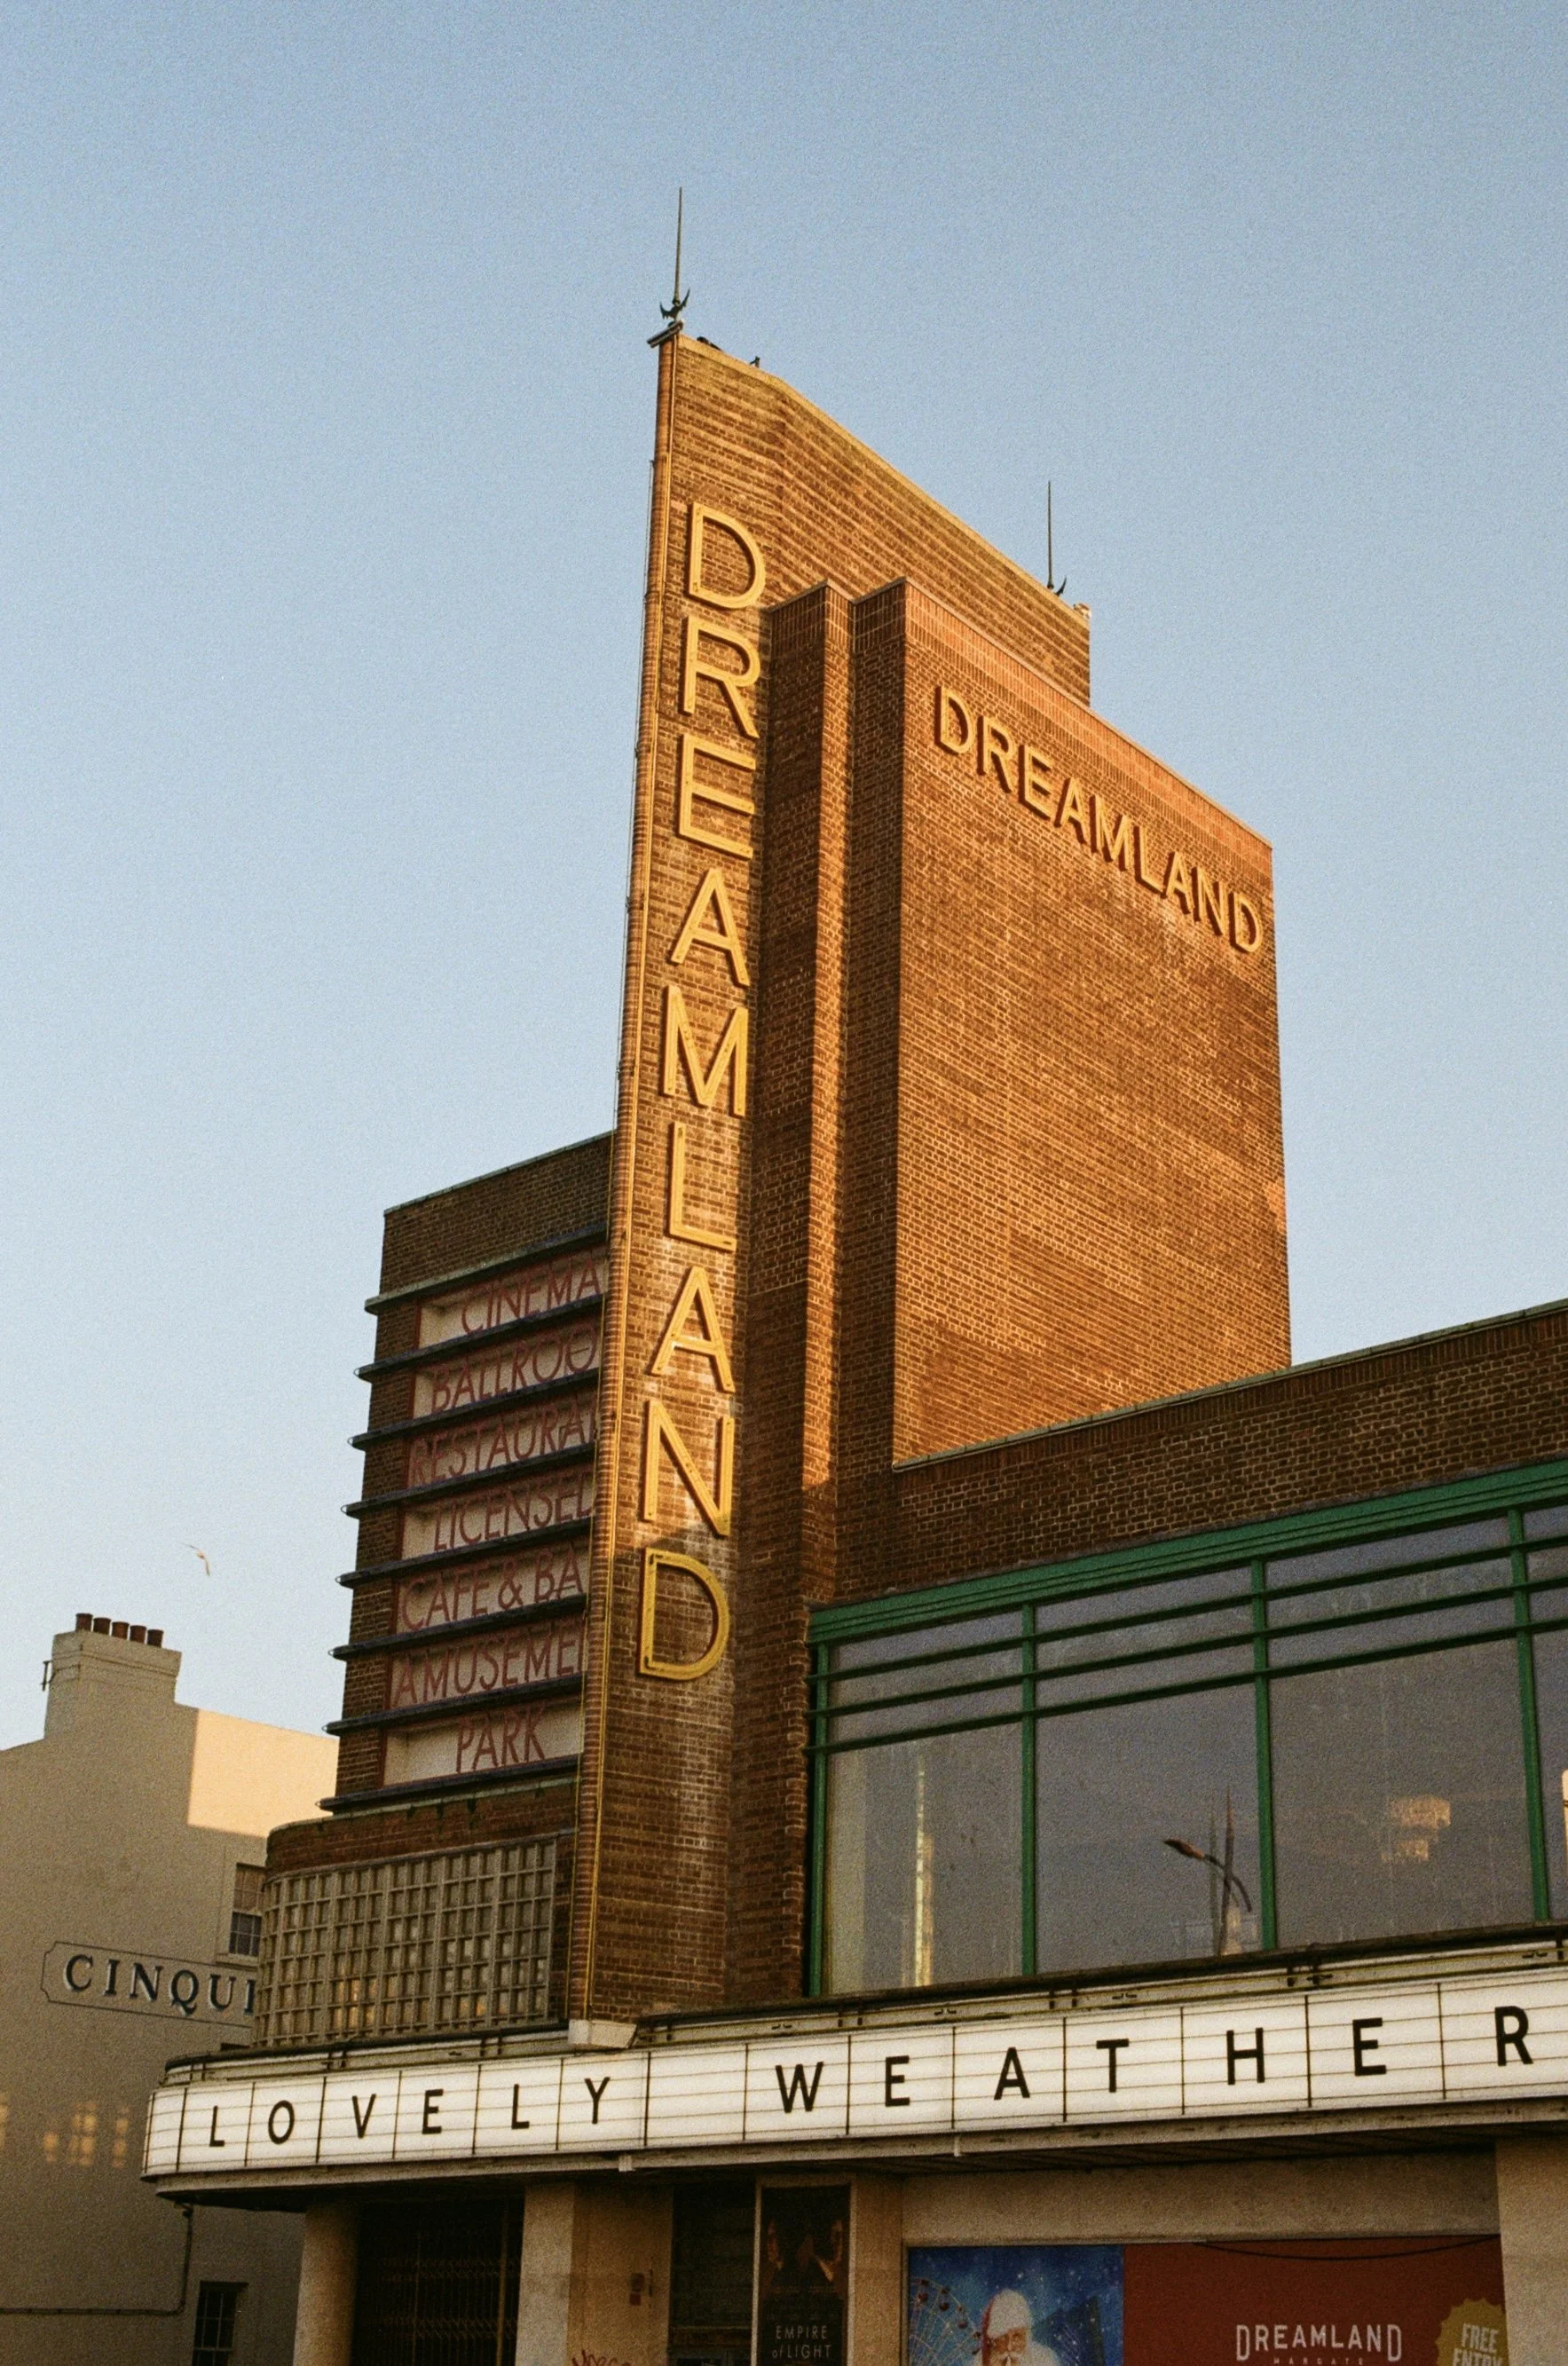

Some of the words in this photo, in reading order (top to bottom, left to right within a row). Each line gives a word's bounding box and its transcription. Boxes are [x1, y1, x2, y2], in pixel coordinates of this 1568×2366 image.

[935, 685, 1264, 953] DREAMLAND
[639, 501, 766, 1680] DREAMLAND
[461, 1252, 601, 1335] CINEMA
[407, 1396, 598, 1483] RESTAURA
[498, 1552, 524, 1611] &
[456, 1702, 545, 1773] PARK
[209, 2077, 611, 2148] LOVELY
[776, 2006, 1533, 2115] WEATHER
[776, 2325, 828, 2340] EMPIRE
[787, 2344, 831, 2359] LIGHT
[1236, 2323, 1402, 2362] DREAMLAND
[1461, 2322, 1500, 2354] FREE
